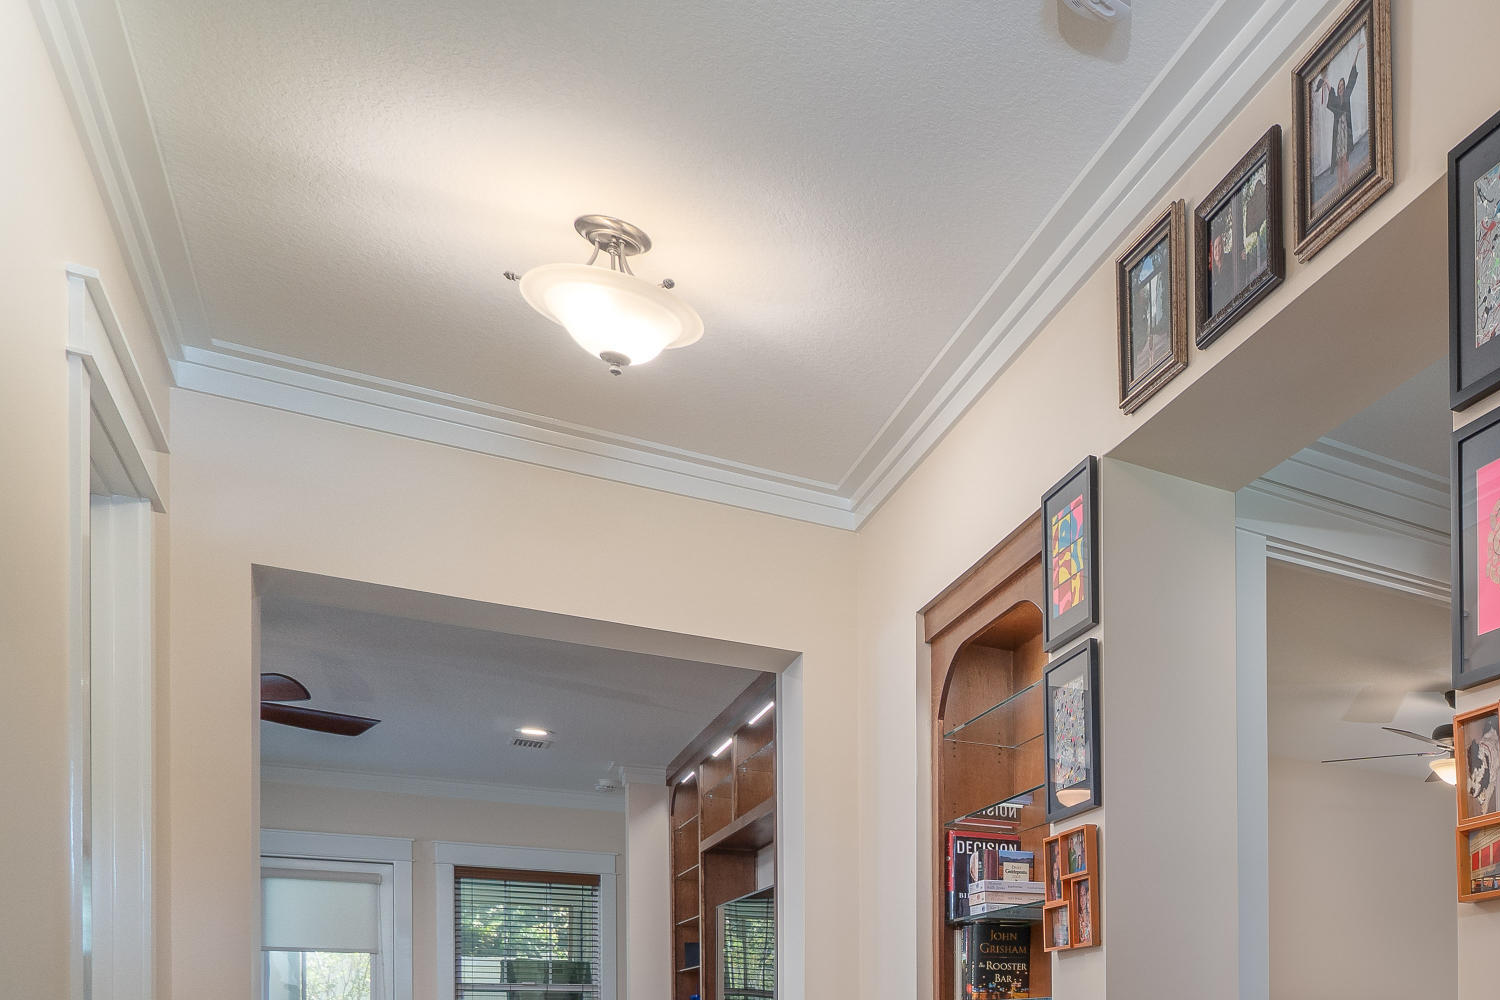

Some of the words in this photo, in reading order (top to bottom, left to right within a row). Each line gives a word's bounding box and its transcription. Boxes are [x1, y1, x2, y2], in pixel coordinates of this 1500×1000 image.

[957, 840, 1017, 854] DECISION
[991, 929, 1017, 941] JOHN
[980, 942, 1026, 953] GRISHAM
[986, 961, 1027, 971] ROOSTER
[995, 974, 1012, 983] BAR
